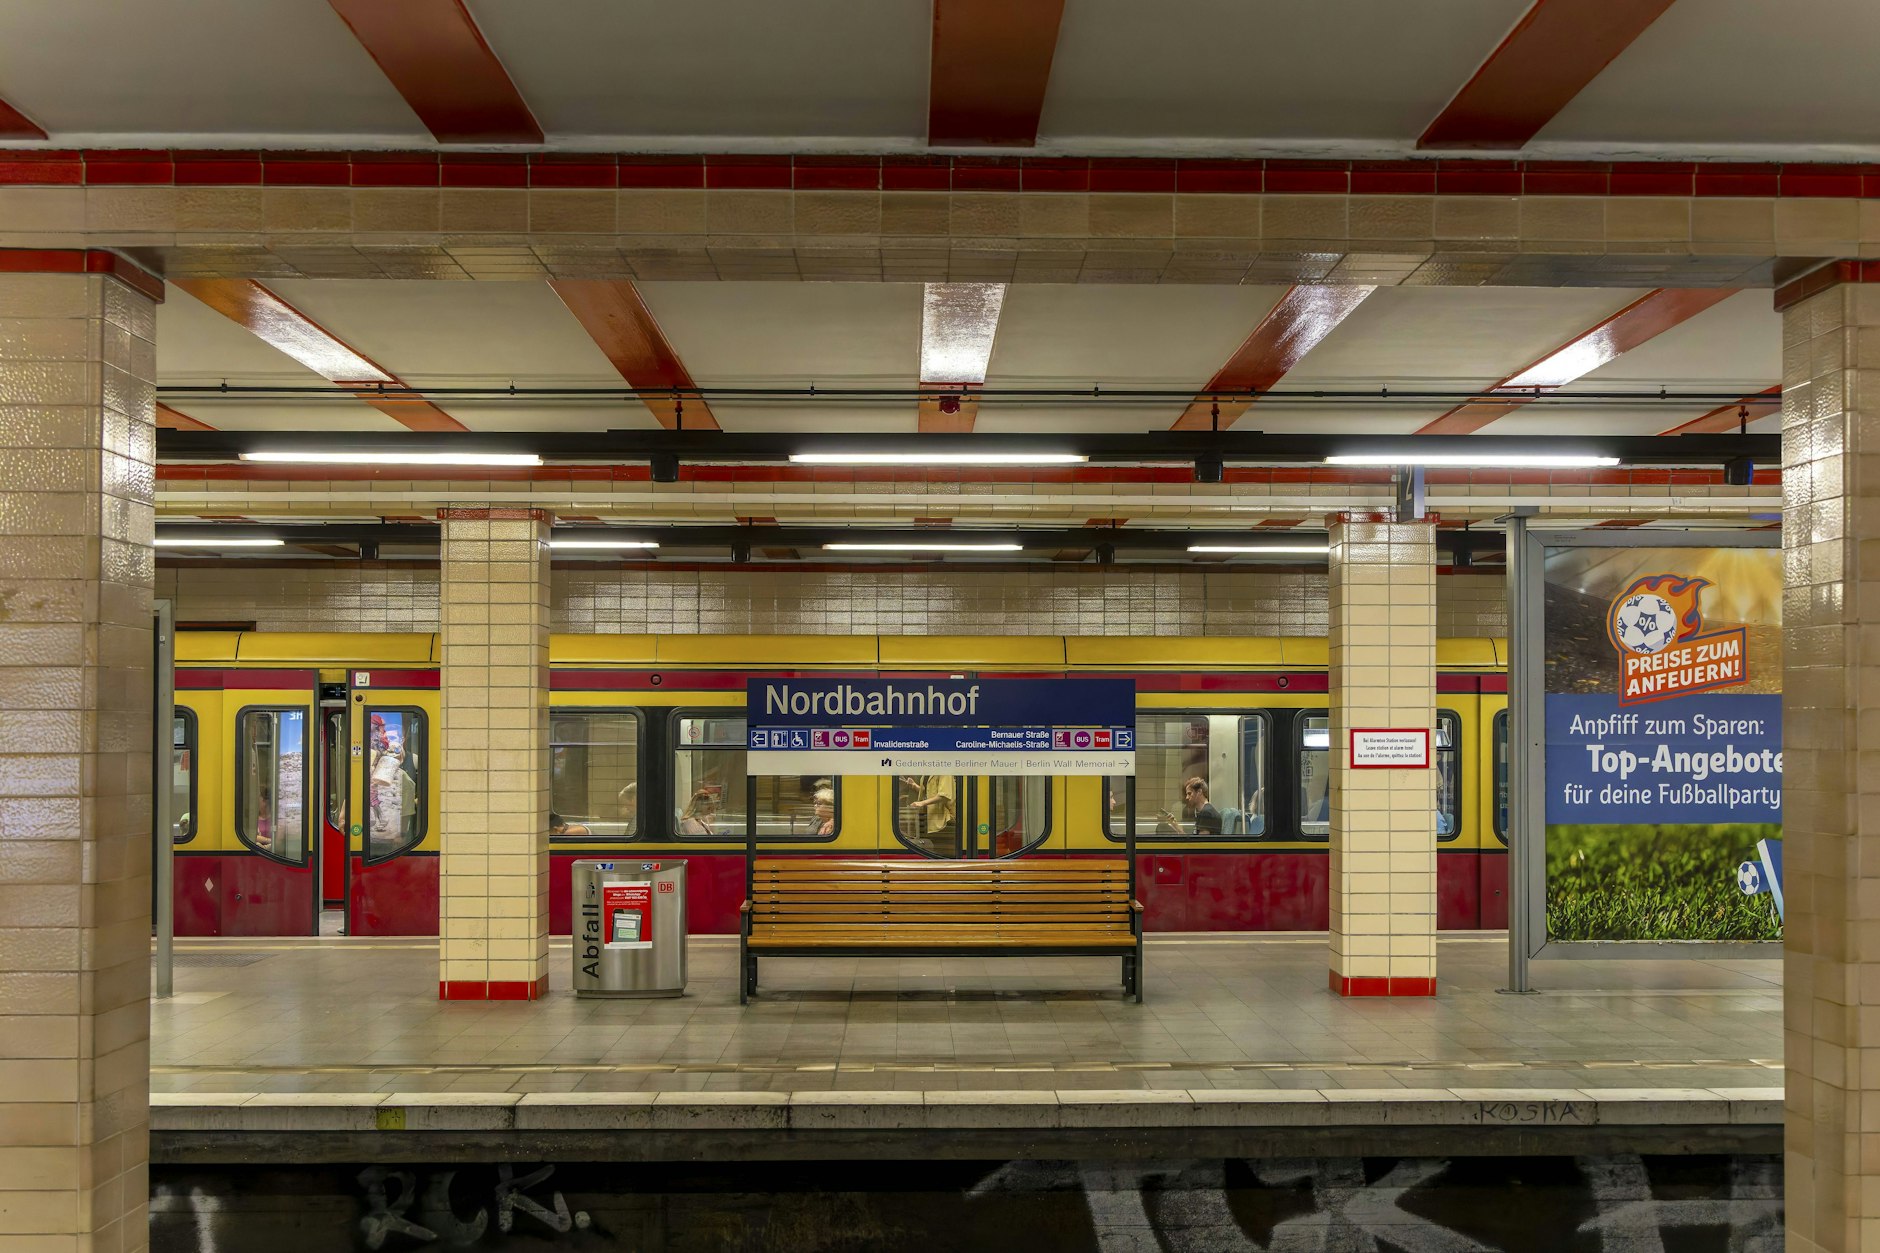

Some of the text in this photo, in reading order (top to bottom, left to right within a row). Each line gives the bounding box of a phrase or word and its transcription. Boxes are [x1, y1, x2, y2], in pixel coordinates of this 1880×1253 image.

[1639, 616, 1656, 631] %
[1627, 640, 1739, 675] PREISE ZUM
[1626, 660, 1740, 696] ANFEUERN!
[766, 685, 979, 715] Nordbahnhof
[991, 730, 1050, 739] Bernauer Straße
[1569, 714, 1765, 740] Anpfiff zum Sparen:
[874, 740, 929, 749] Invalidenstraße
[955, 740, 1050, 749] Caroline-Michaelis-Straße
[895, 759, 1116, 768] Gedenkstätte Berliner Mauer Berlin Wall Memorial
[1564, 783, 1781, 810] für deine Fußballparty
[659, 883, 673, 892] DB
[582, 904, 600, 979] Abfall
